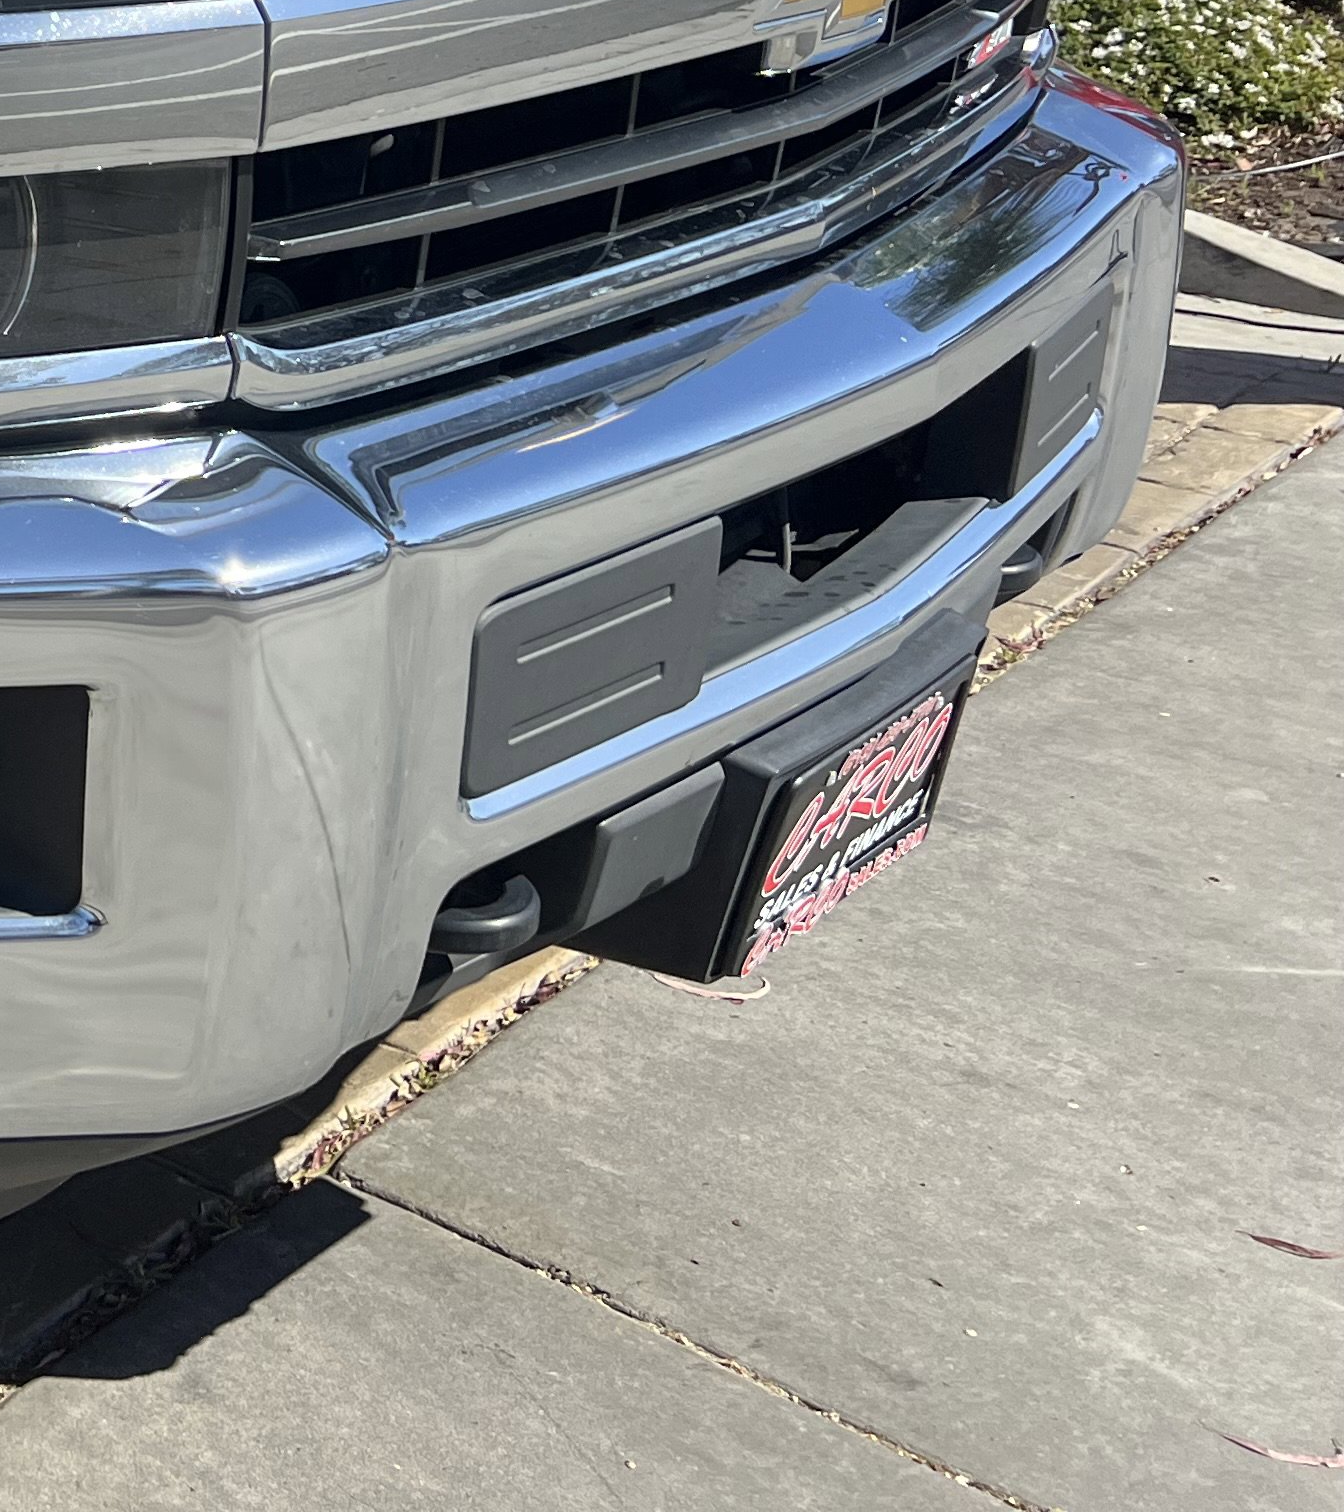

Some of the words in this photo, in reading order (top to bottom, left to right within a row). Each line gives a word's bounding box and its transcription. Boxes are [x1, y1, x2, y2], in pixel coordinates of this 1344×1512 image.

[753, 864, 824, 930] SALES
[839, 788, 925, 868] FINANCE
[761, 702, 954, 898] CARCO
